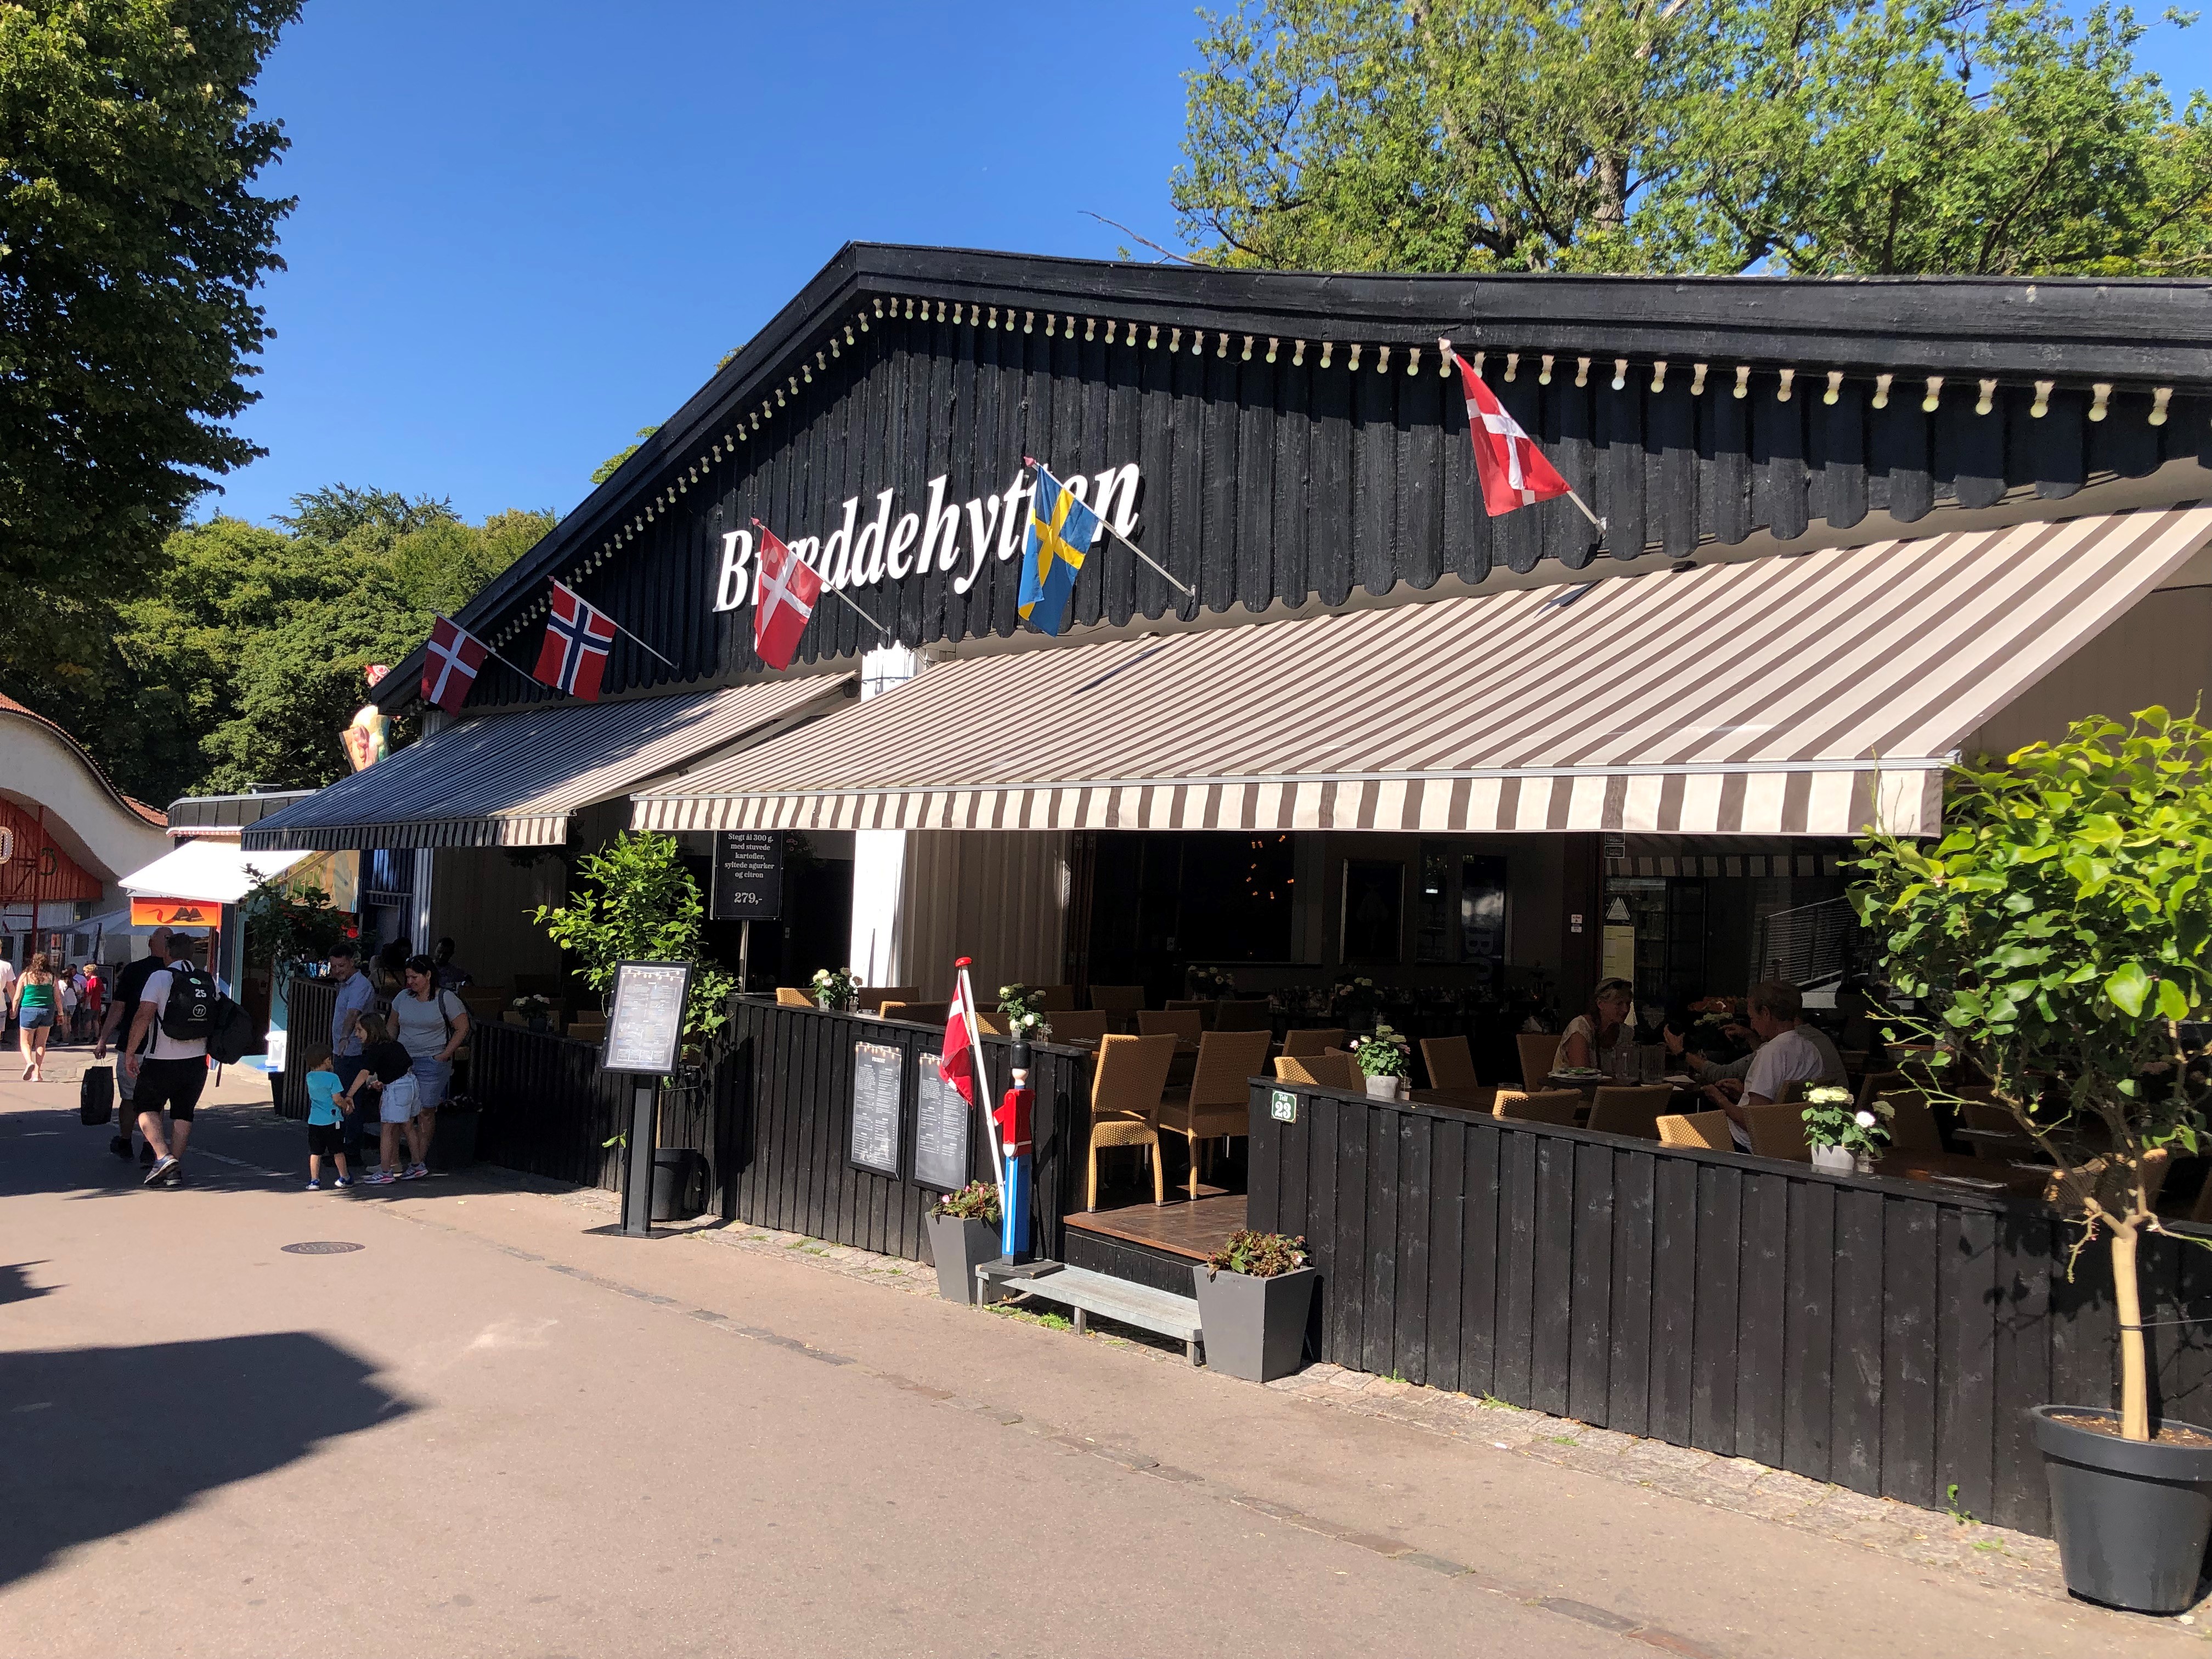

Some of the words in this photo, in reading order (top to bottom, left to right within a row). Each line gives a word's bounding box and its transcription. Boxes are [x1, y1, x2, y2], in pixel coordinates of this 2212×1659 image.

[728, 833, 745, 842] Stegt
[735, 852, 765, 861] kartofler,
[724, 861, 748, 870] syltede
[734, 892, 763, 905] 279,-
[195, 989, 207, 998] 25
[1274, 1101, 1291, 1119] 23
